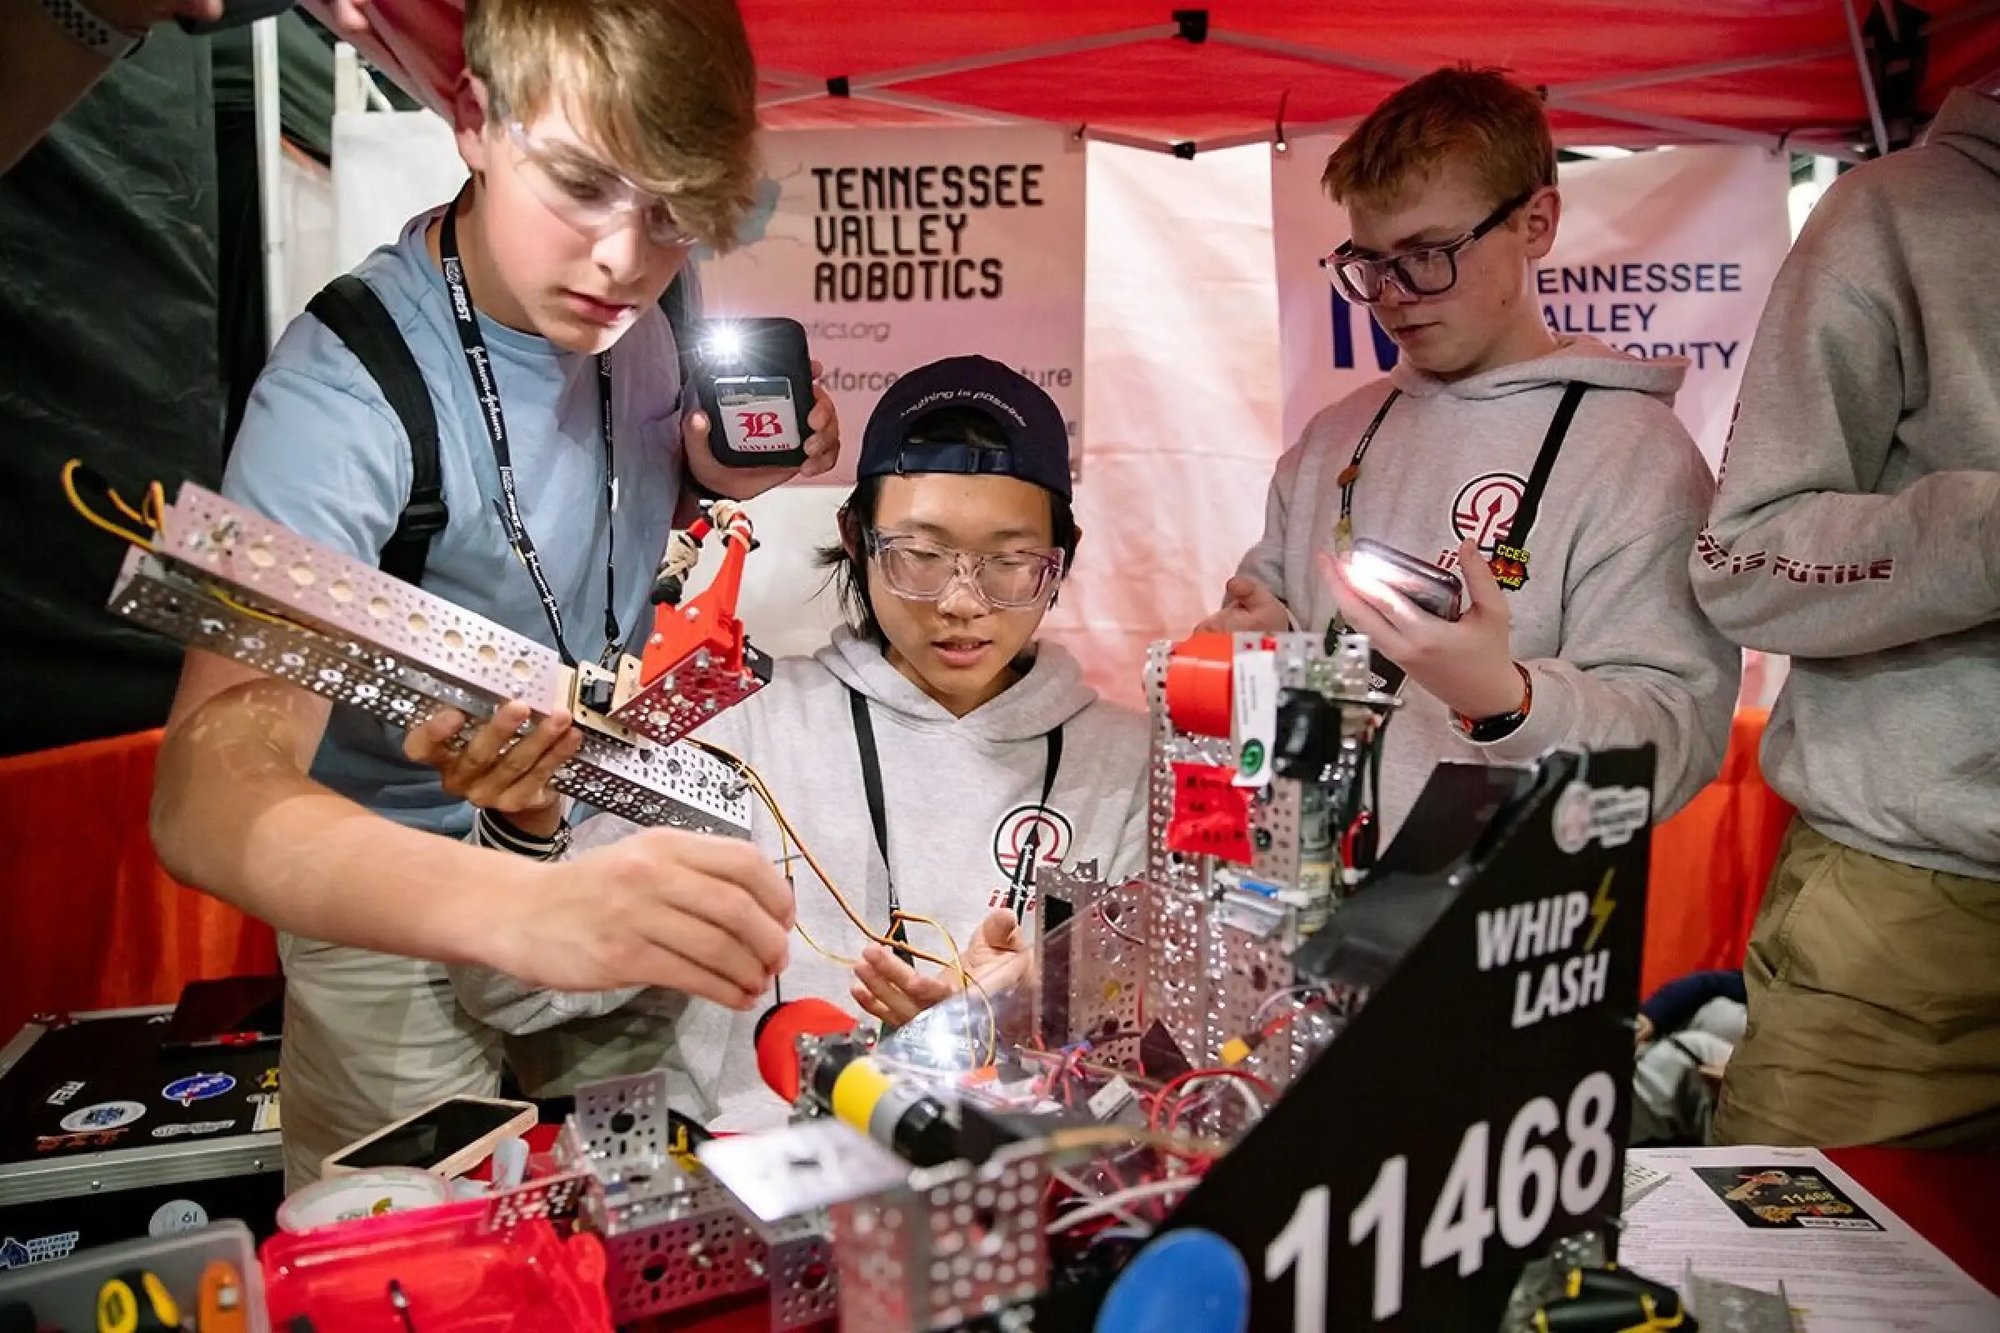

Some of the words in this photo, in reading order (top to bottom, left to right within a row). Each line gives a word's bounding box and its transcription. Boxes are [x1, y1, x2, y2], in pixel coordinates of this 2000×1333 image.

[811, 164, 1045, 211] TENNESSEE
[814, 212, 967, 257] VALLEY
[814, 258, 1003, 302] ROBOTICS
[1537, 264, 1741, 294] ENNESSEE
[1543, 304, 1657, 332] ALLEY
[1771, 554, 1895, 586] FUTILE
[1476, 891, 1590, 972] WHIP
[1510, 948, 1611, 1030] LASH
[1265, 1070, 1616, 1333] 11468
